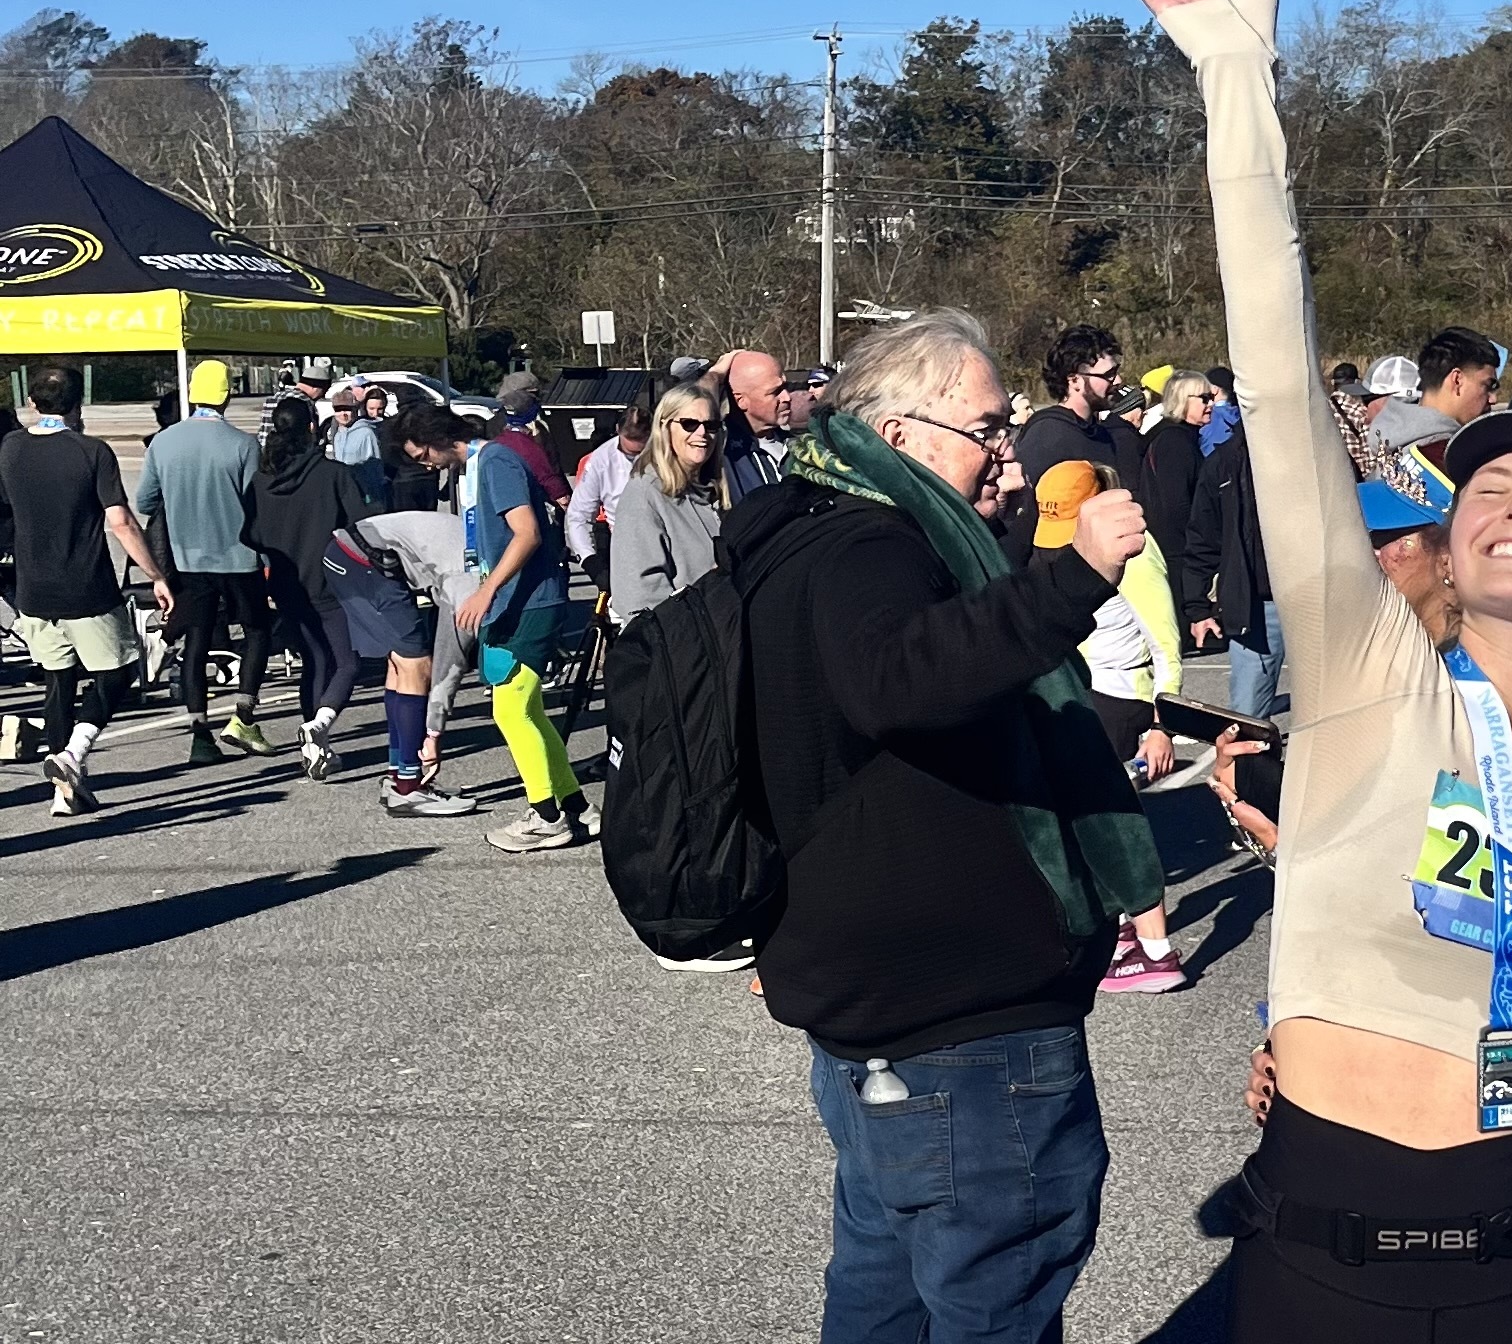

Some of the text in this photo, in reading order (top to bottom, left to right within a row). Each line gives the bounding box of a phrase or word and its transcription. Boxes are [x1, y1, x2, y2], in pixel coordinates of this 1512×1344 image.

[190, 307, 271, 332] STRETCH
[1481, 755, 1504, 836] Rhode Island
[1450, 919, 1481, 941] GEAR
[1115, 962, 1146, 977] HOKA
